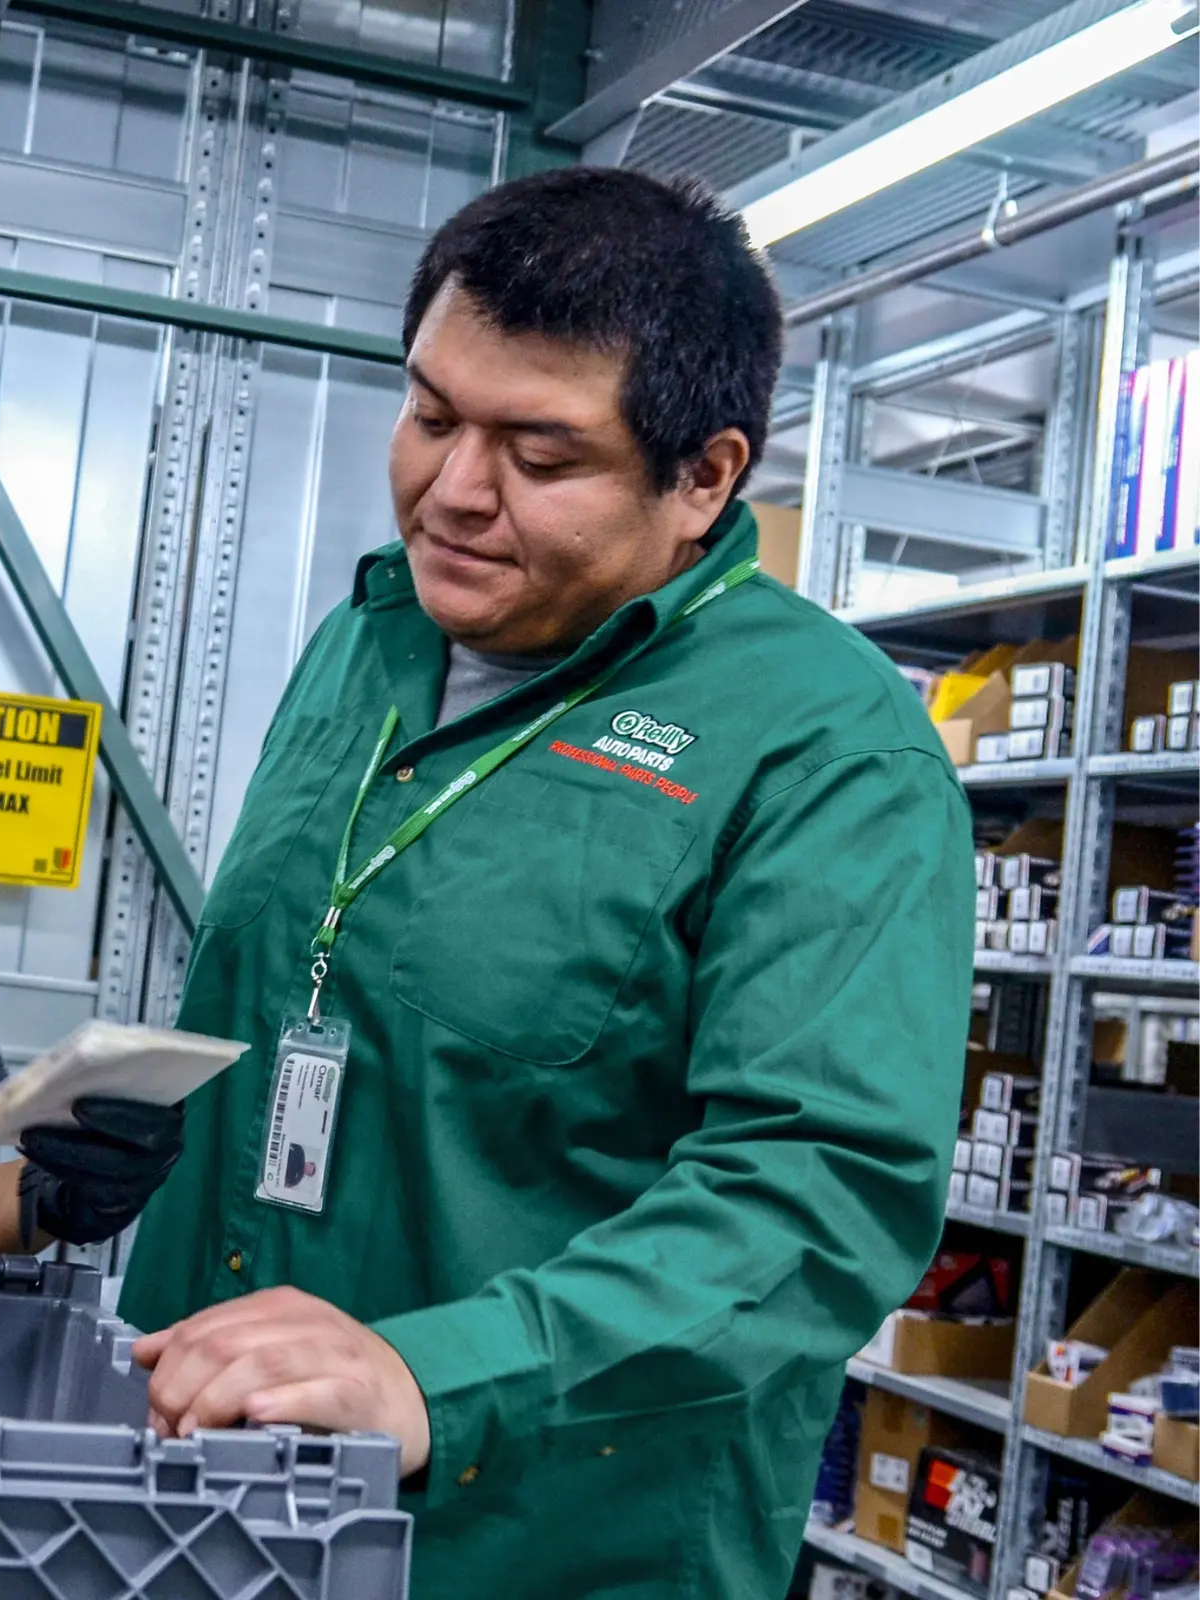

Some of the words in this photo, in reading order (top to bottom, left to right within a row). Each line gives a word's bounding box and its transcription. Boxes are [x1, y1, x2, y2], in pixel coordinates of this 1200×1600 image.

[612, 711, 694, 754] O'Reilly
[592, 735, 631, 757] AUTO
[625, 746, 675, 771] PARTS
[15, 762, 64, 785] Limit
[619, 764, 656, 785] PARTS
[653, 777, 698, 804] PEOPLE
[313, 1064, 327, 1101] Omar
